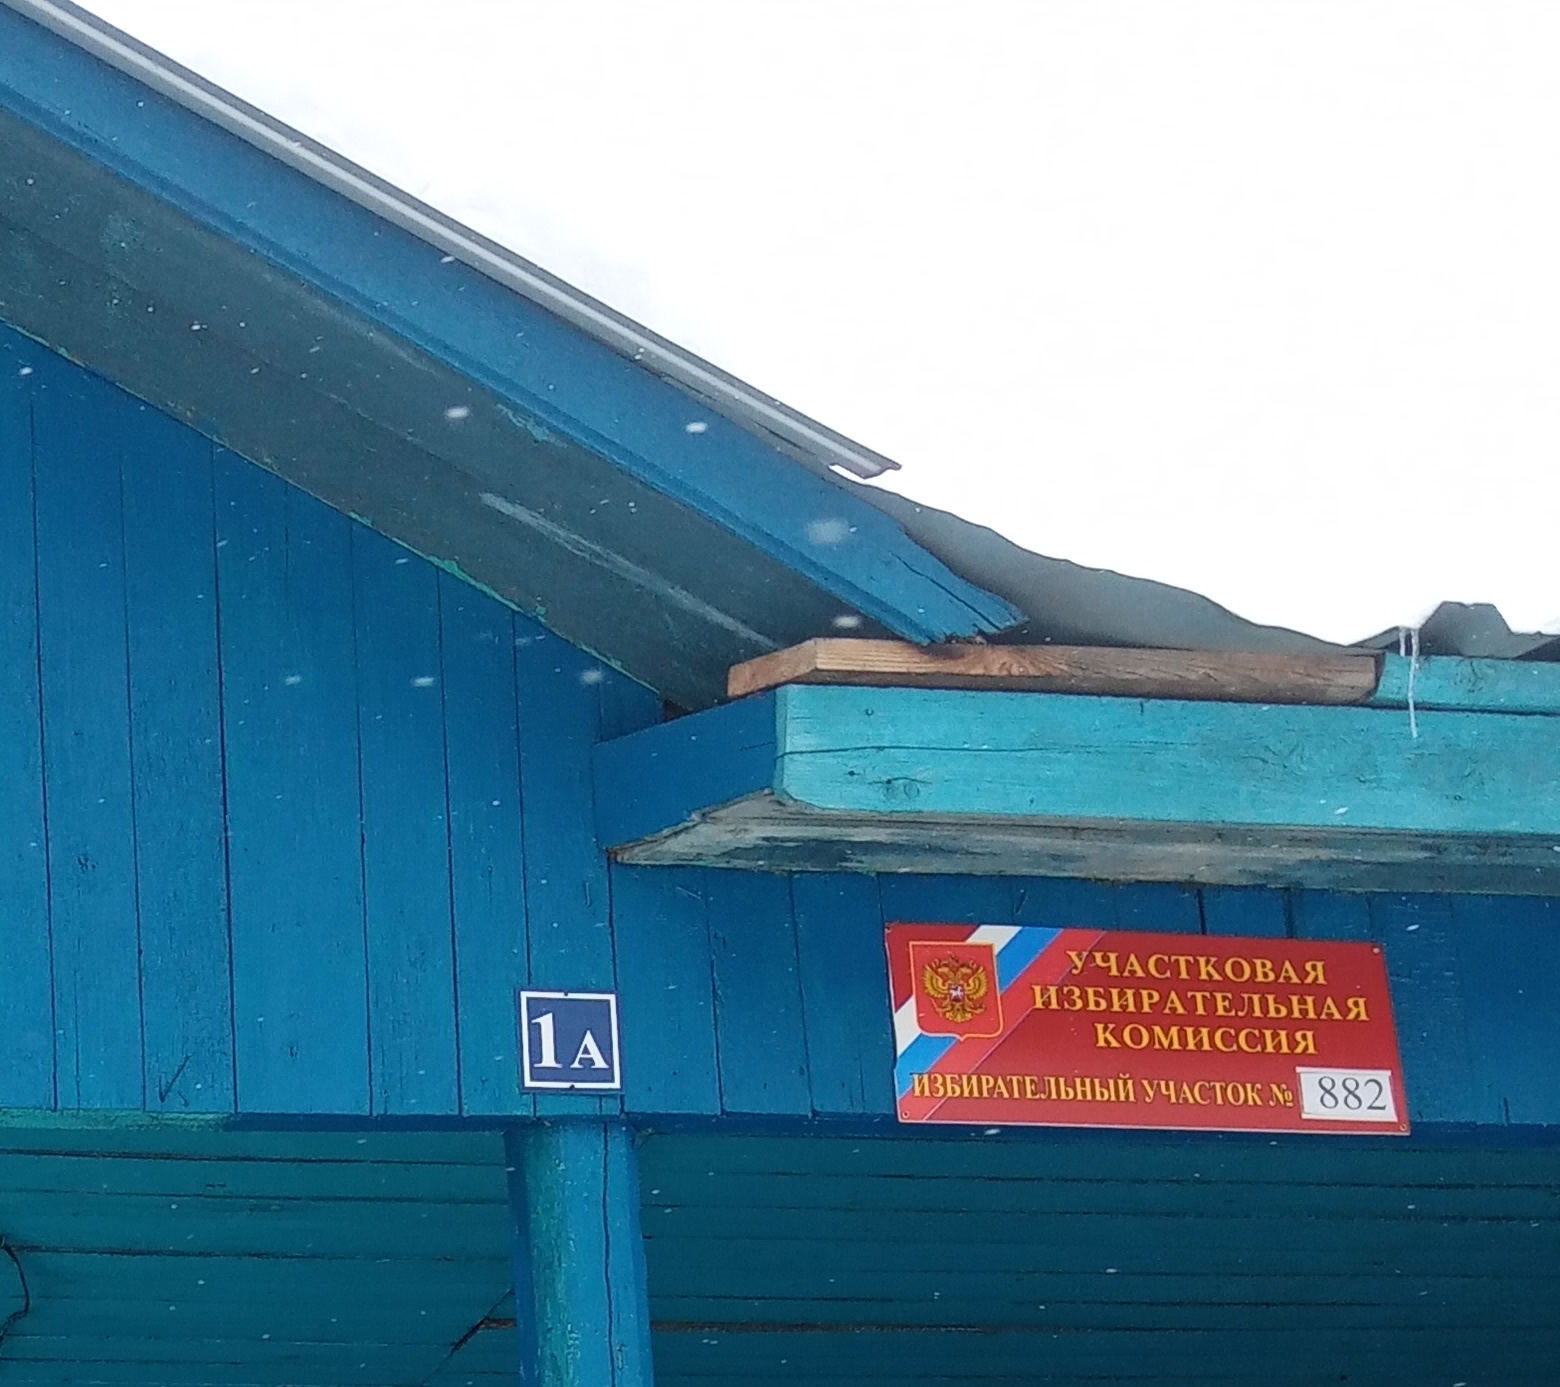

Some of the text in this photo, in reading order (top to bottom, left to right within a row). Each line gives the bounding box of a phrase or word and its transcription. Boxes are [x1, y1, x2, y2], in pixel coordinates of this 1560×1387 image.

[1065, 950, 1328, 986] УЧАСТКОВАЯ
[1032, 984, 1371, 1022] ИЗБИРАТЕЛЬНАЯ
[1094, 1023, 1319, 1055] КОМИССИЯ
[911, 1071, 1388, 1113] ИЗБИРАТЕЛЬНЫЙ УЧАСТОК № 882
